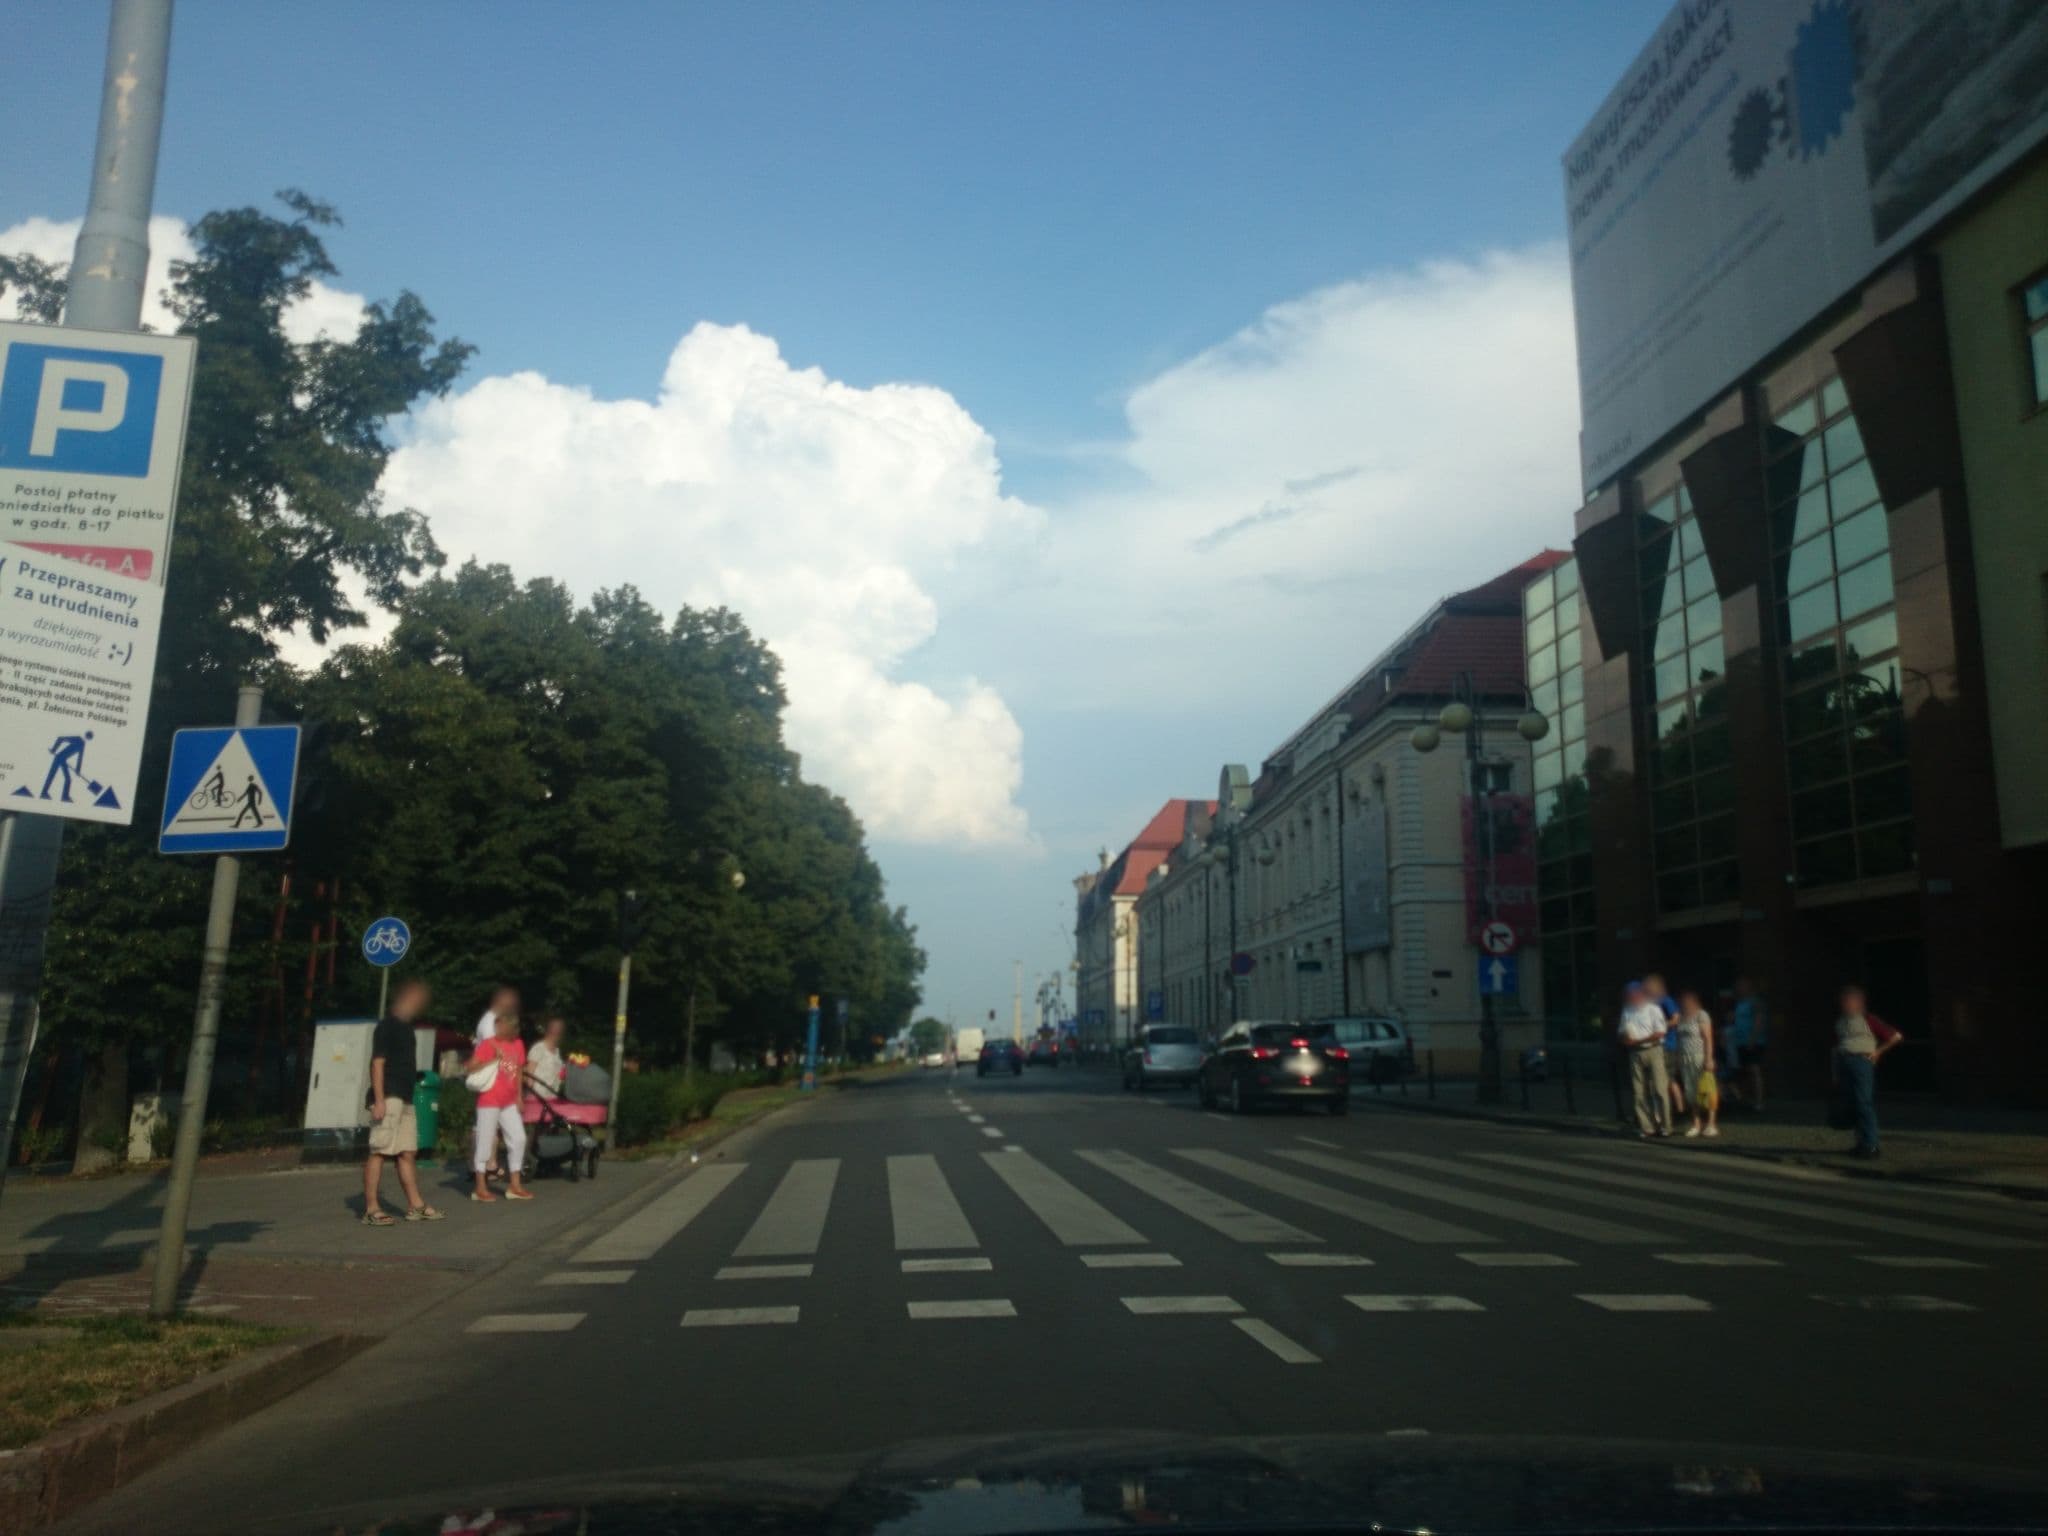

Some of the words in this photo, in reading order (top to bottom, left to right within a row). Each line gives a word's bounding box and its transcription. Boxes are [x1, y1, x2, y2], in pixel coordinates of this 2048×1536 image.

[29, 357, 129, 456] P
[67, 488, 117, 504] płatny
[12, 518, 24, 527] w
[91, 506, 111, 517] do
[117, 508, 165, 521] piątku
[120, 554, 135, 573] A
[18, 561, 137, 608] Przepraszamy
[14, 586, 34, 600] za
[40, 593, 139, 628] utrudnienia
[33, 617, 102, 642] dziękujemy
[8, 629, 101, 658] wyrozumiałość
[87, 712, 128, 728] Polskiego
